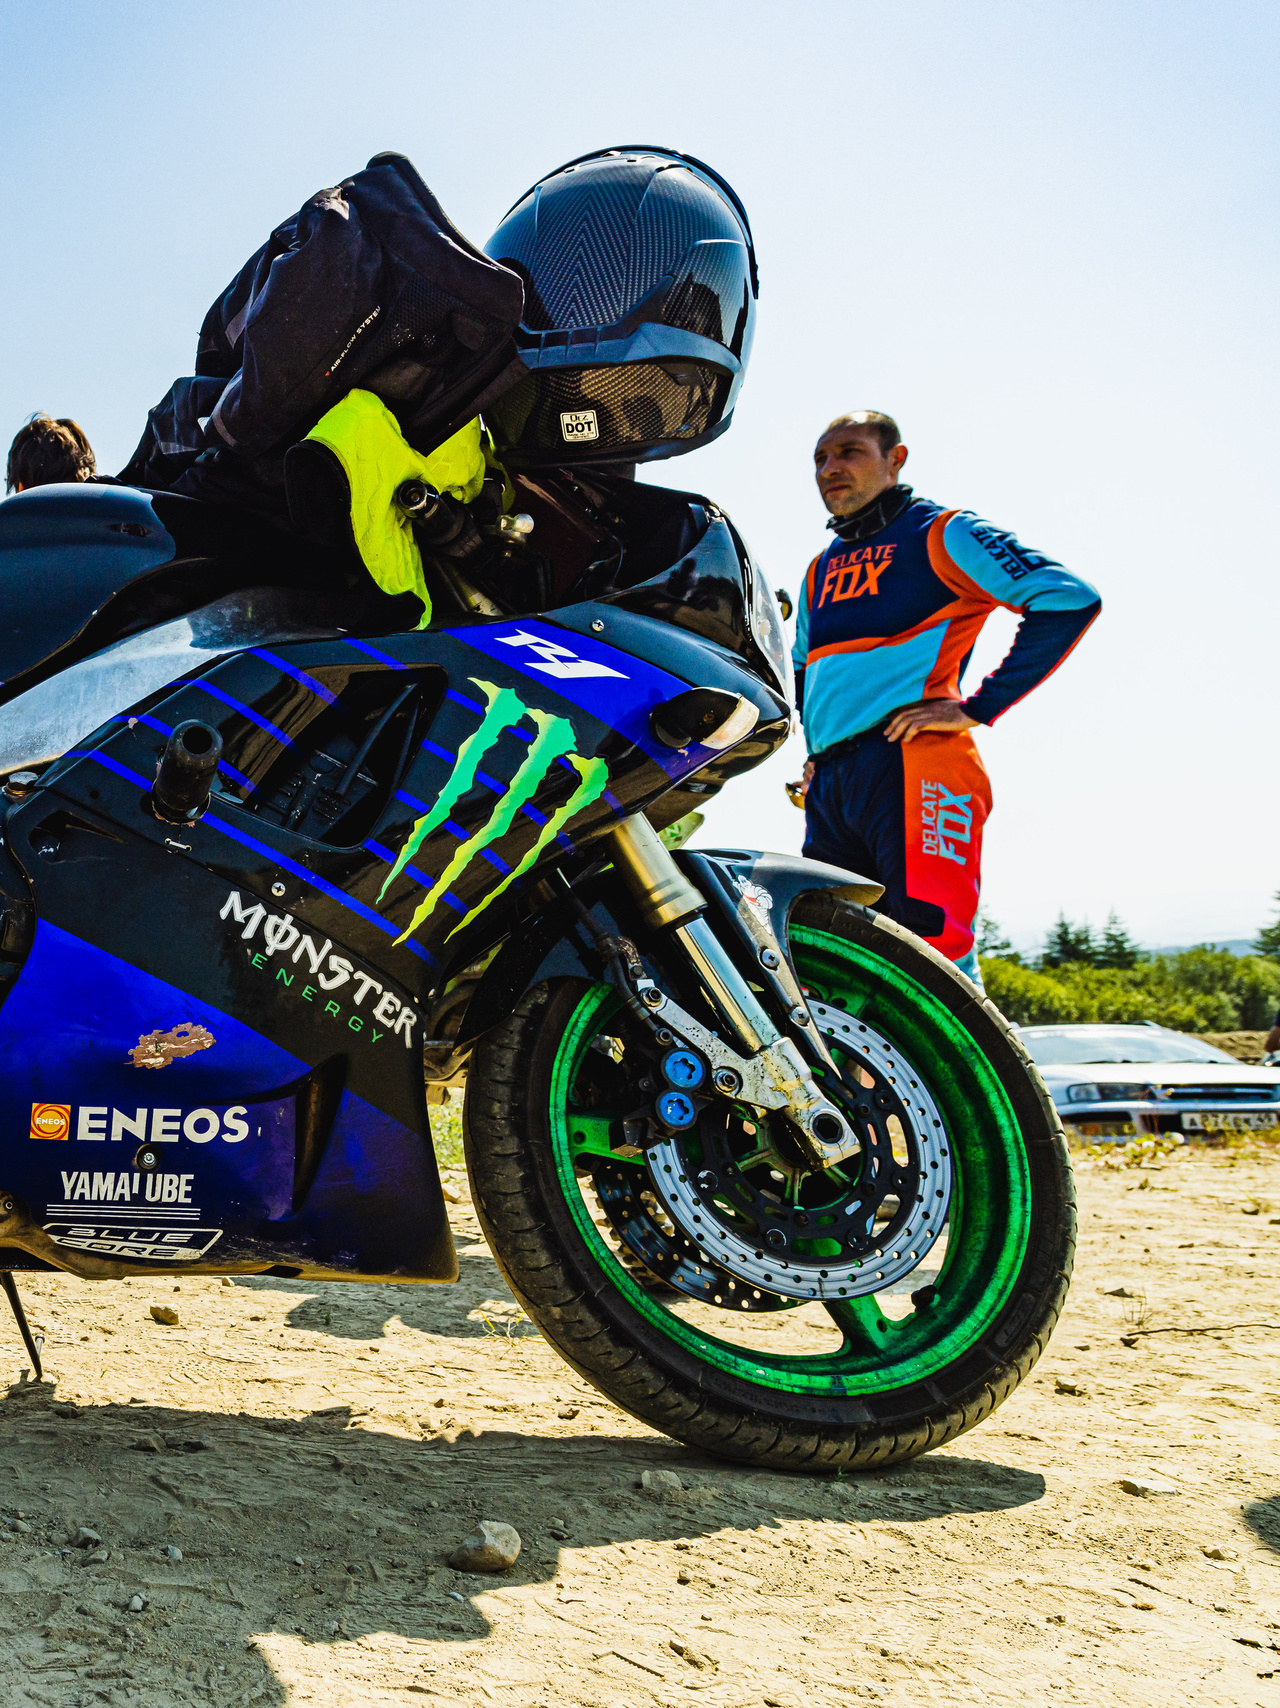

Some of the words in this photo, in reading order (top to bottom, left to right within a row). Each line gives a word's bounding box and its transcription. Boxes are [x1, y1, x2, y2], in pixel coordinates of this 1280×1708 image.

[330, 333, 357, 372] AIR-FLOW
[565, 421, 593, 433] DOT
[826, 543, 898, 574] DELICATE
[970, 528, 1028, 582] DELICATE
[817, 559, 893, 609] FOX
[922, 779, 938, 855] DELICATE
[938, 782, 973, 866] FOX
[219, 890, 417, 1048] MONSTER
[251, 952, 384, 1043] ENERGY
[35, 1116, 66, 1126] ENEOS
[76, 1105, 250, 1144] ENEOS
[56, 1237, 181, 1258] CORE
[67, 1227, 194, 1243] BLUE
